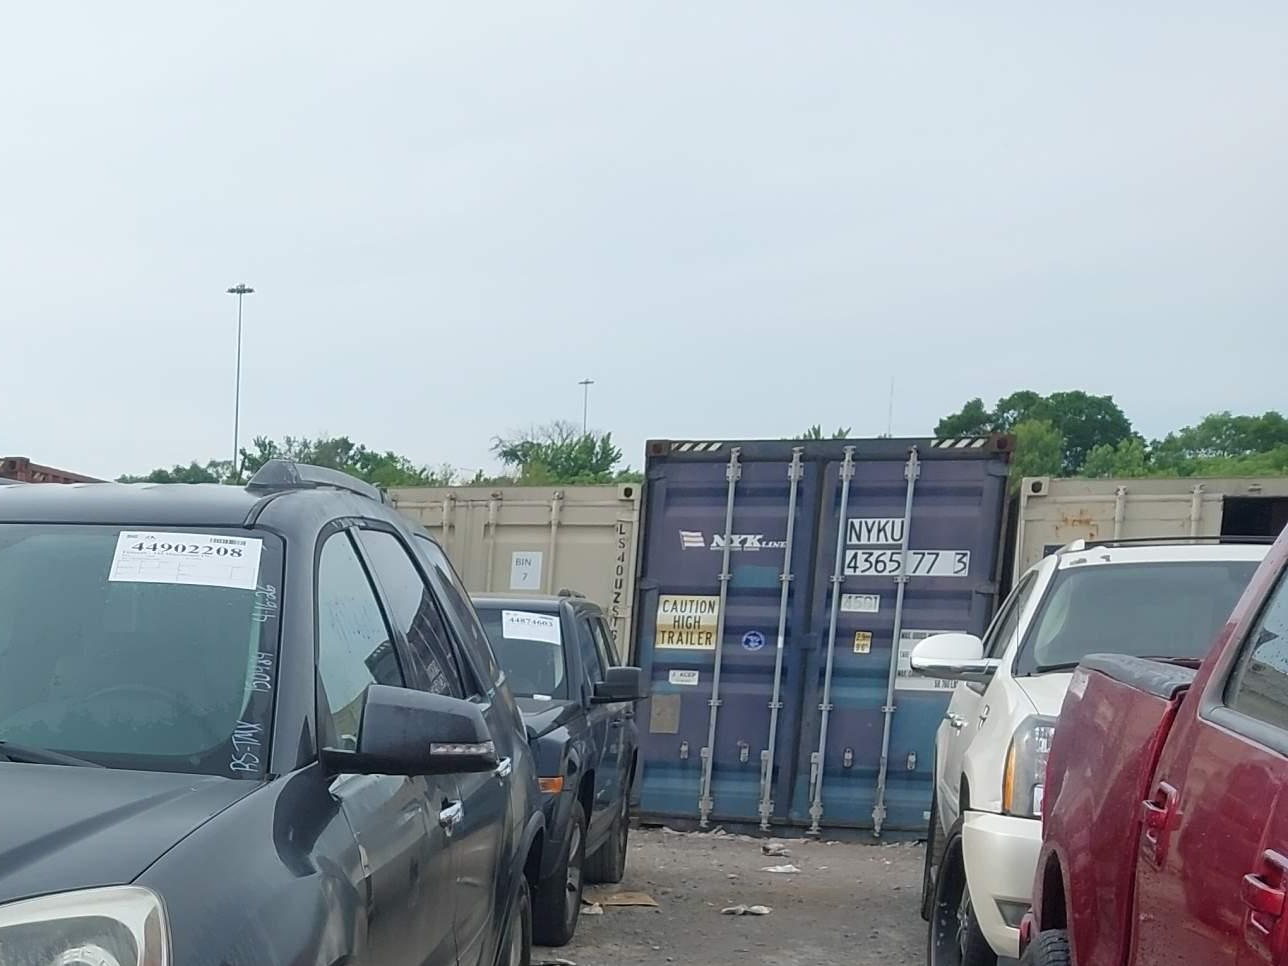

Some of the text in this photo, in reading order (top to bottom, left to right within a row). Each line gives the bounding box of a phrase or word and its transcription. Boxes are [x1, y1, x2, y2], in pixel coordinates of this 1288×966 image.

[848, 519, 904, 543] NYKU
[131, 541, 244, 558] 44902208
[710, 534, 764, 551] NYK
[515, 557, 532, 568] BIN
[953, 552, 968, 574] 3
[521, 572, 529, 582] 7
[662, 599, 716, 614] CAUTION
[672, 615, 701, 630] HIGH
[660, 630, 713, 646] TRAILER
